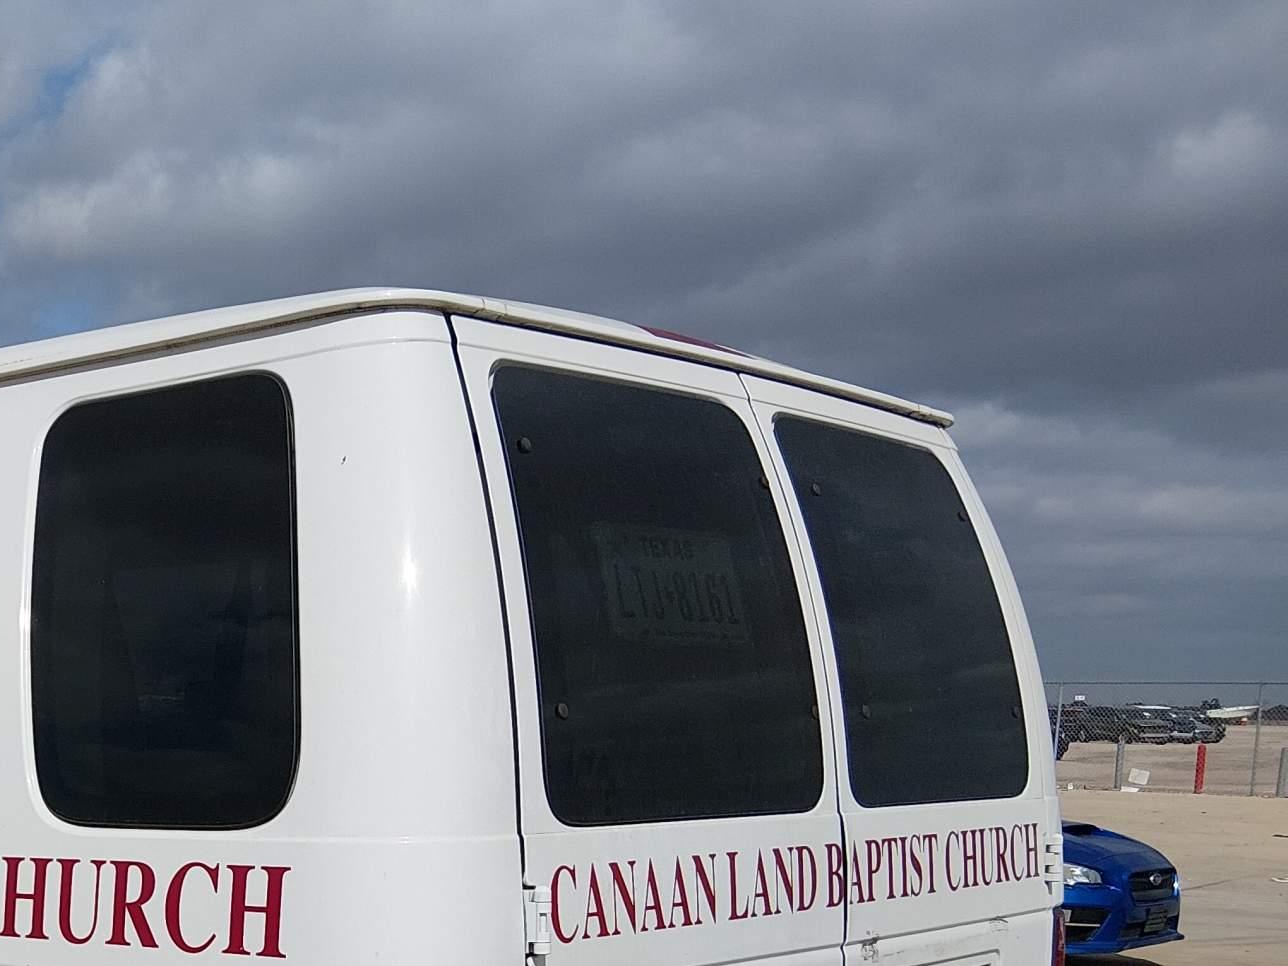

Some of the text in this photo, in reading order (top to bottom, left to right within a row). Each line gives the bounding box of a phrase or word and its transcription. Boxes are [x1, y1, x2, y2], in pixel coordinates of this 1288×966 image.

[550, 822, 1040, 944] CANAAN LAND BAPTIST CHURCH
